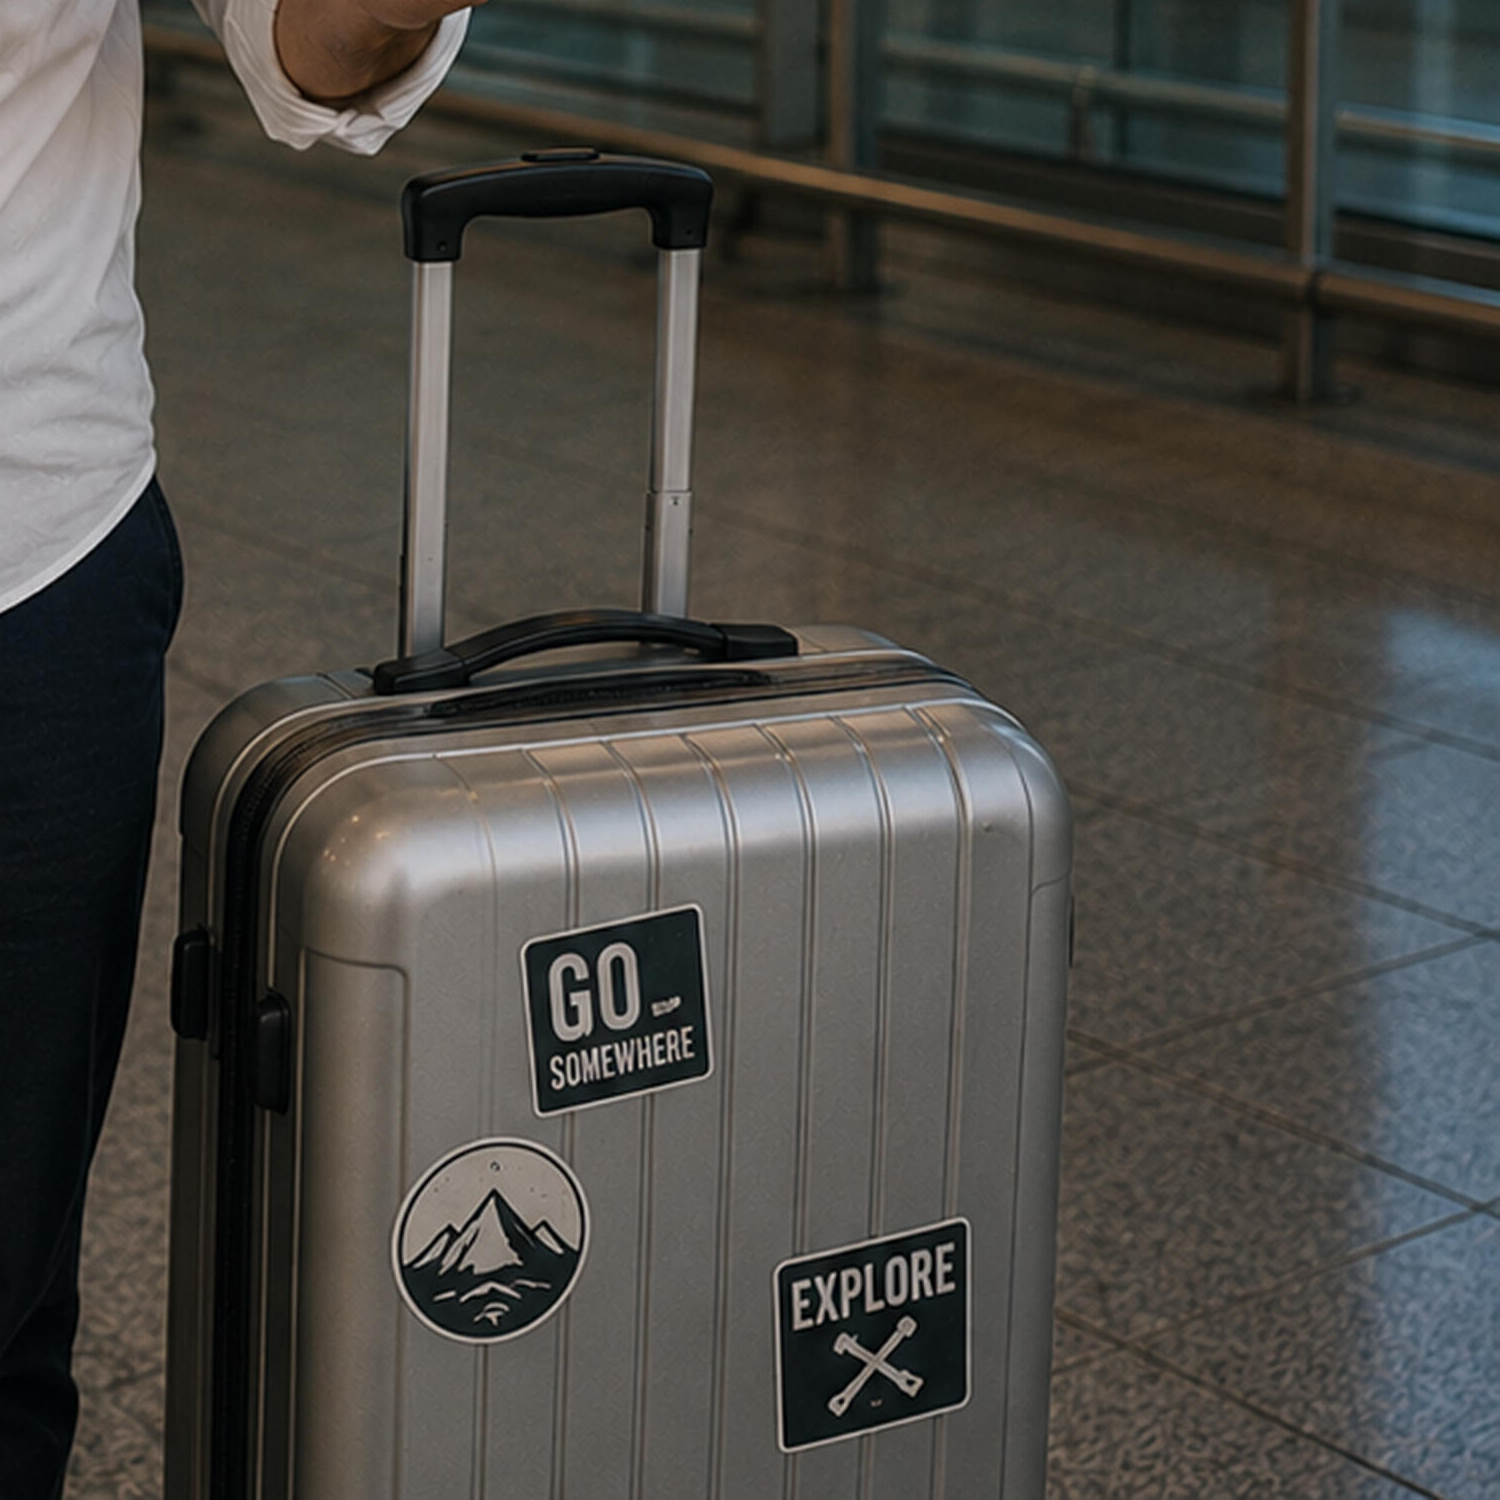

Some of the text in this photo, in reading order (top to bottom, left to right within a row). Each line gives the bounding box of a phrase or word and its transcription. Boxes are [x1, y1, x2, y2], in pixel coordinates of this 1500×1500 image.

[548, 942, 641, 1042] GO
[550, 1025, 695, 1091] SOMEWHERE
[791, 1242, 956, 1331] EXPLORE
